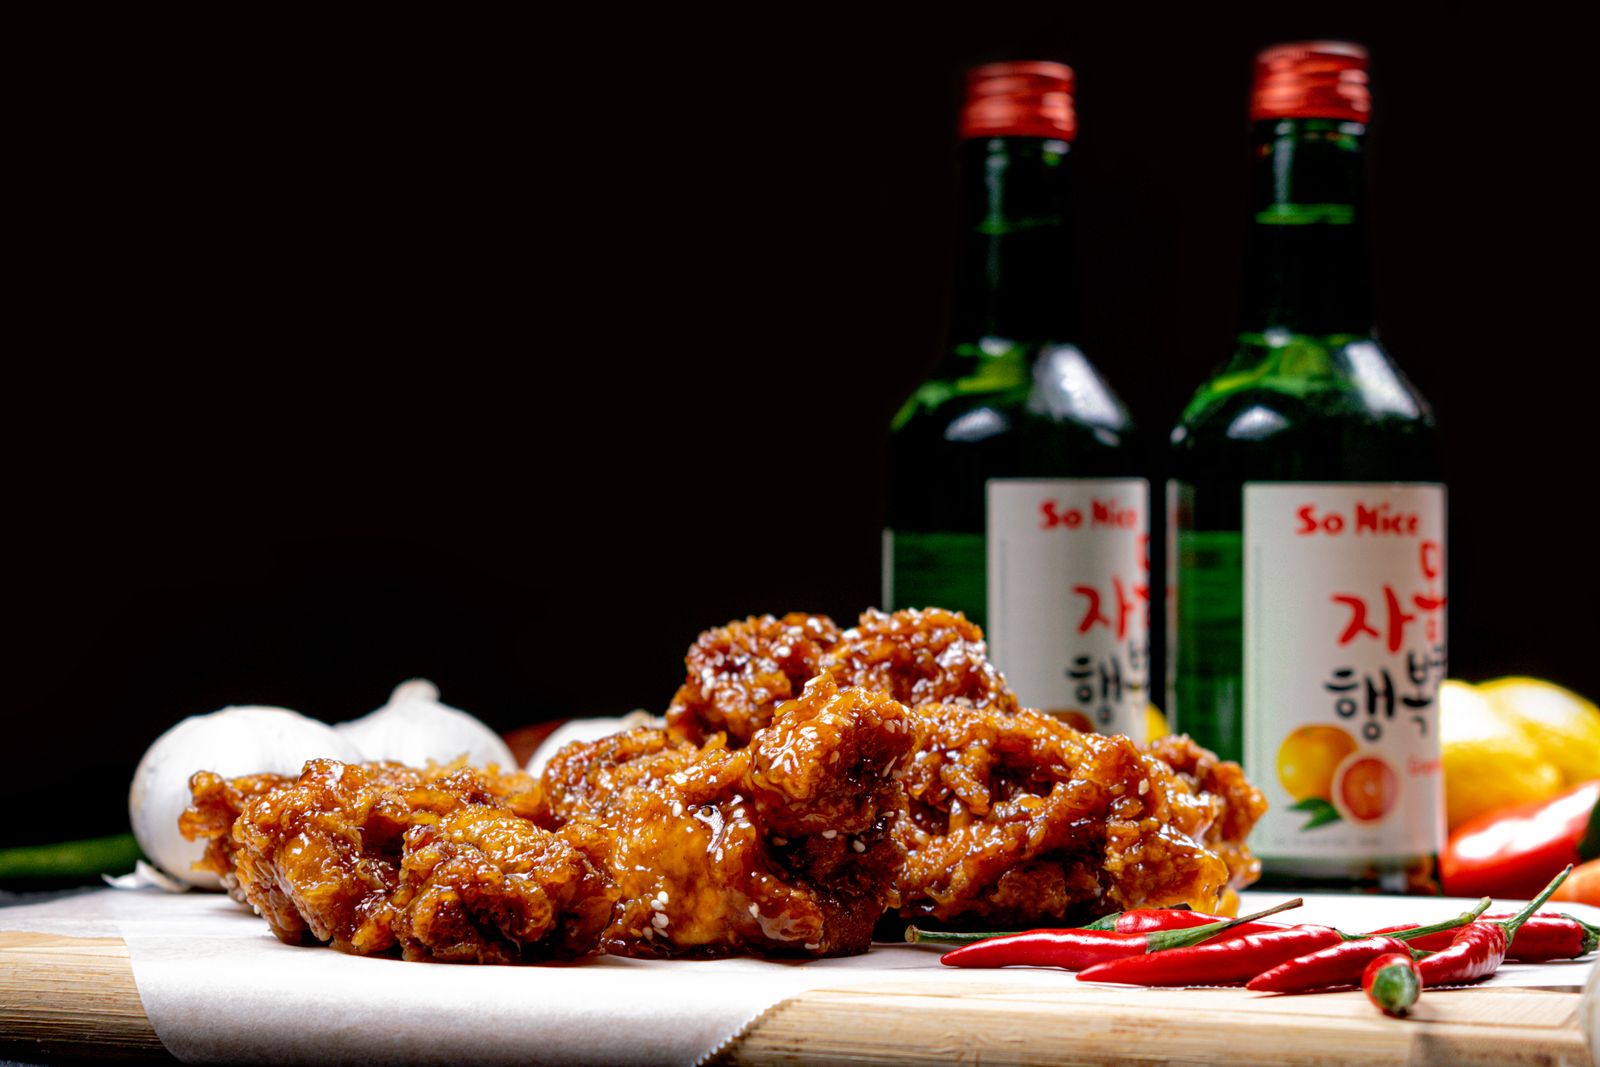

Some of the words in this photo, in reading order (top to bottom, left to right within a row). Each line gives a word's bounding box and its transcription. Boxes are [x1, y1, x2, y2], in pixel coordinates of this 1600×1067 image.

[1040, 501, 1082, 531] So
[1092, 499, 1137, 530] Nice
[1296, 504, 1345, 535] So
[1355, 502, 1419, 534] Nice
